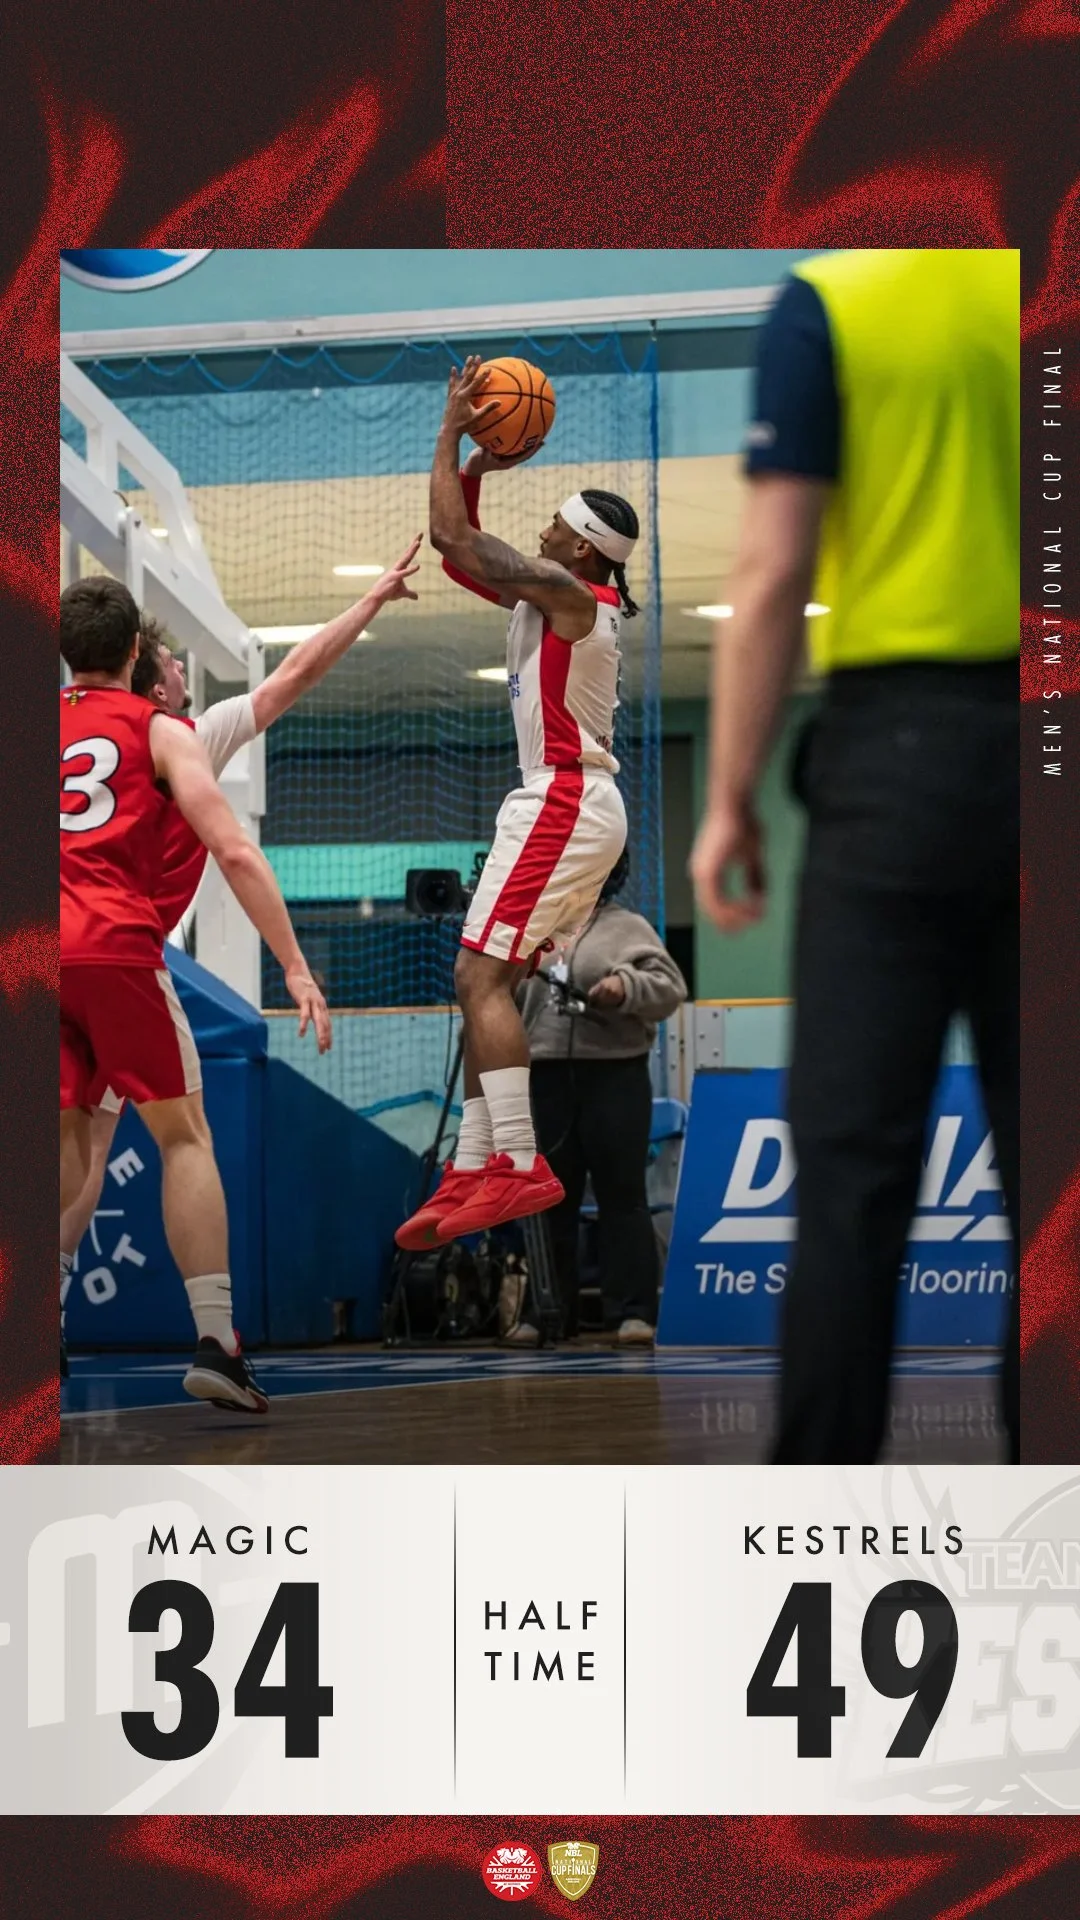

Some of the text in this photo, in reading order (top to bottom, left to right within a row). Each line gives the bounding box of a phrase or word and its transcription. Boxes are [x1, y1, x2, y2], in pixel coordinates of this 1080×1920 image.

[60, 736, 120, 832] 3
[695, 1262, 757, 1294] The
[899, 1261, 1013, 1298] loorin
